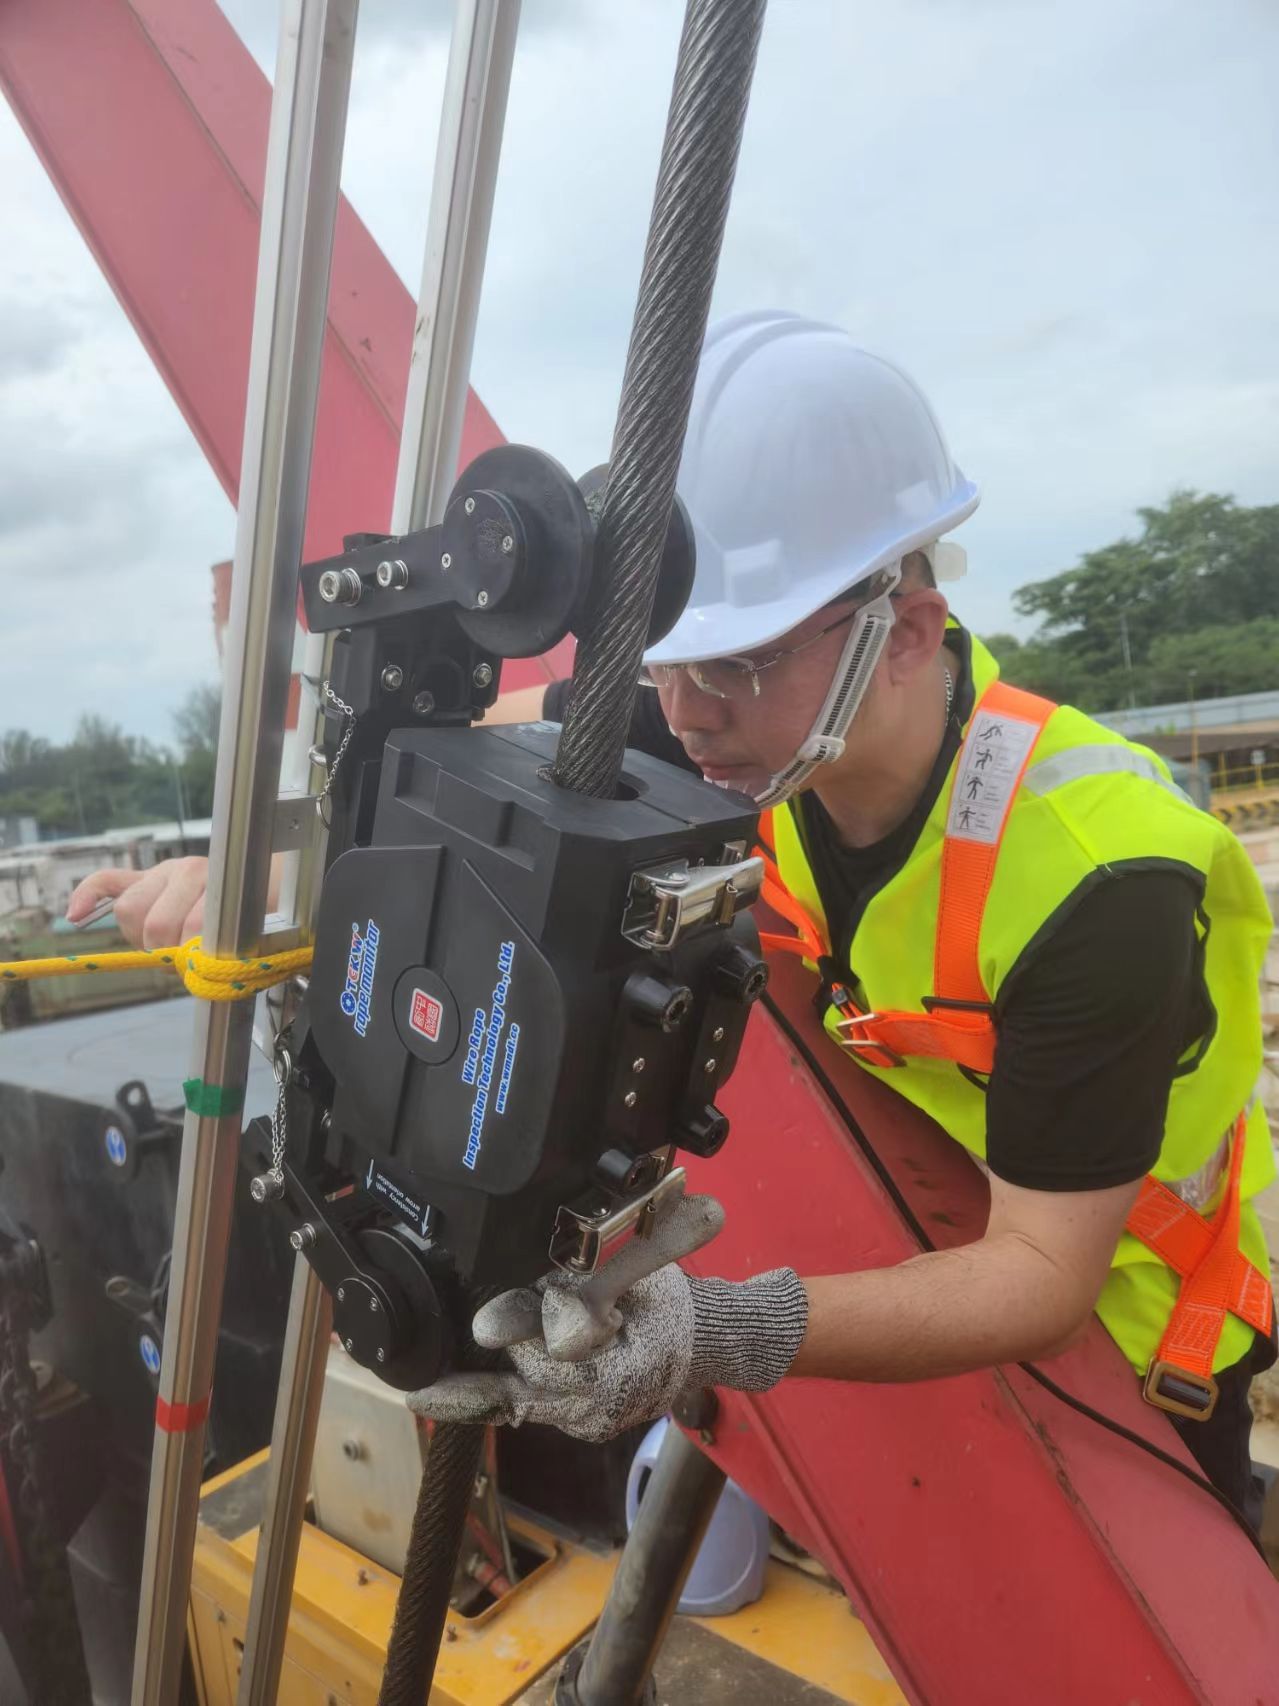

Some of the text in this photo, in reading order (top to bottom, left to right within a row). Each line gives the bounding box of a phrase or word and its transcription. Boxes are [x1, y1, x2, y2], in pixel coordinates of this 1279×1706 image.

[354, 919, 380, 1037] rope monitor
[462, 1008, 486, 1084] Wire Rope
[463, 941, 515, 1170] Inspection Technology Co., Ltd.
[495, 1023, 520, 1114] www.wmndt.cc
